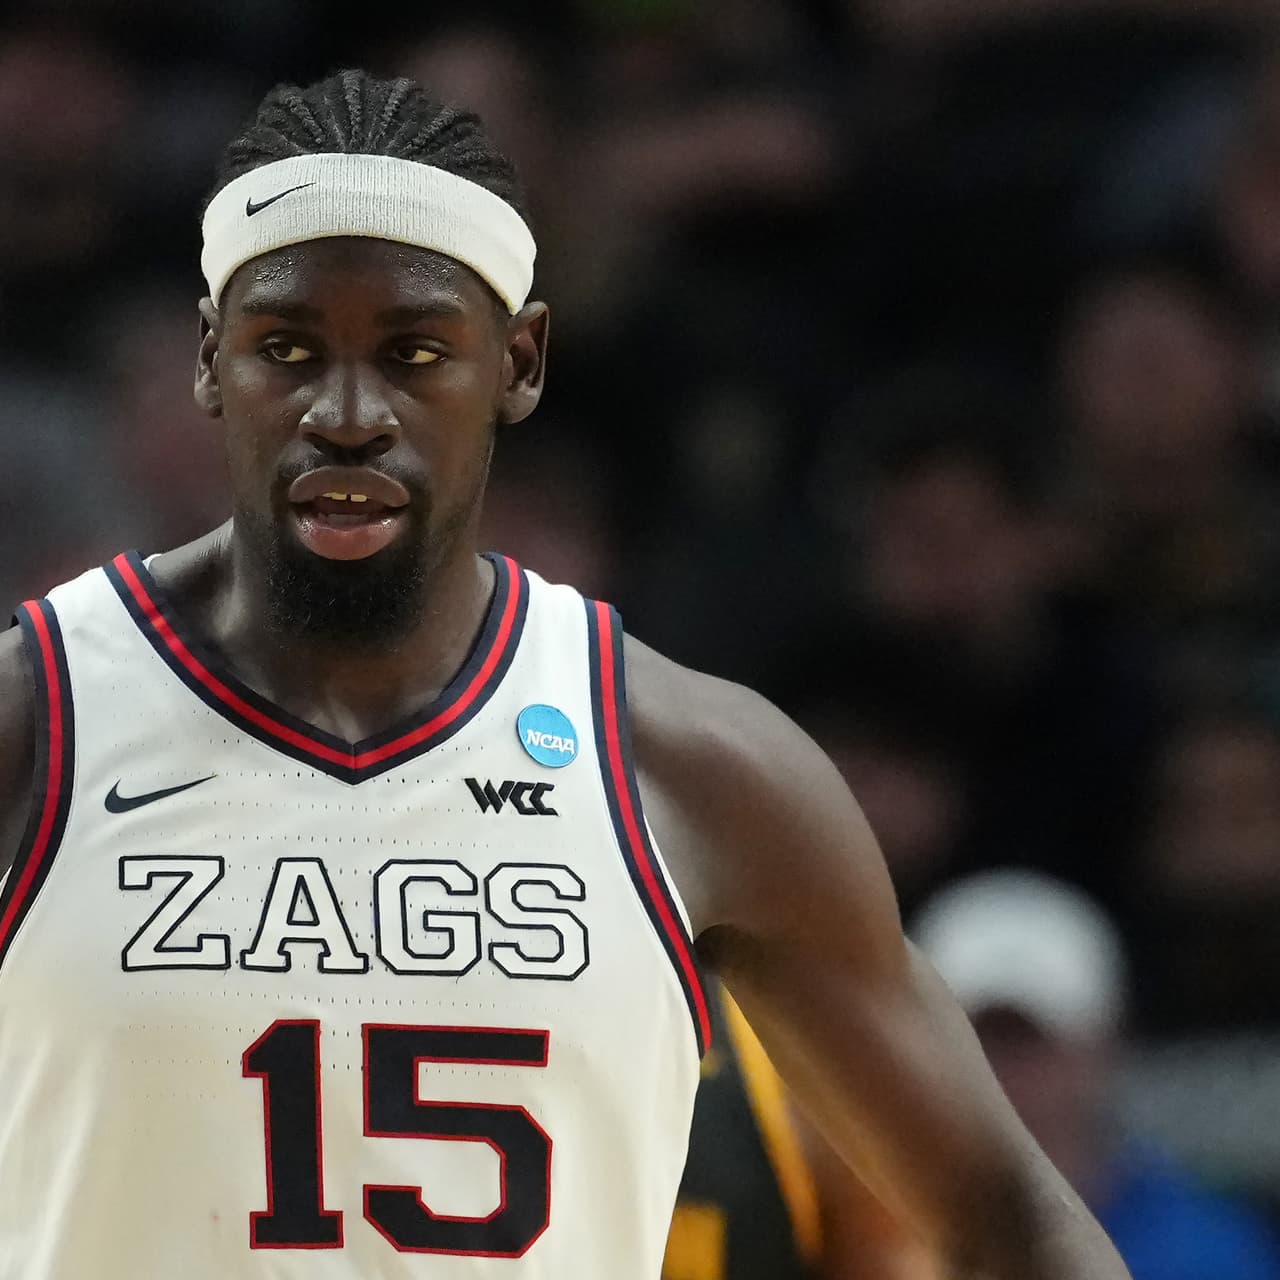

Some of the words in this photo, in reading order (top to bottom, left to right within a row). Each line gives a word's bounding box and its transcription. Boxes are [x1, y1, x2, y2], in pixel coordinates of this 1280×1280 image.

[526, 729, 575, 754] NCAA
[464, 778, 558, 816] WCC
[119, 856, 590, 981] ZAGS
[241, 1018, 553, 1258] 15
